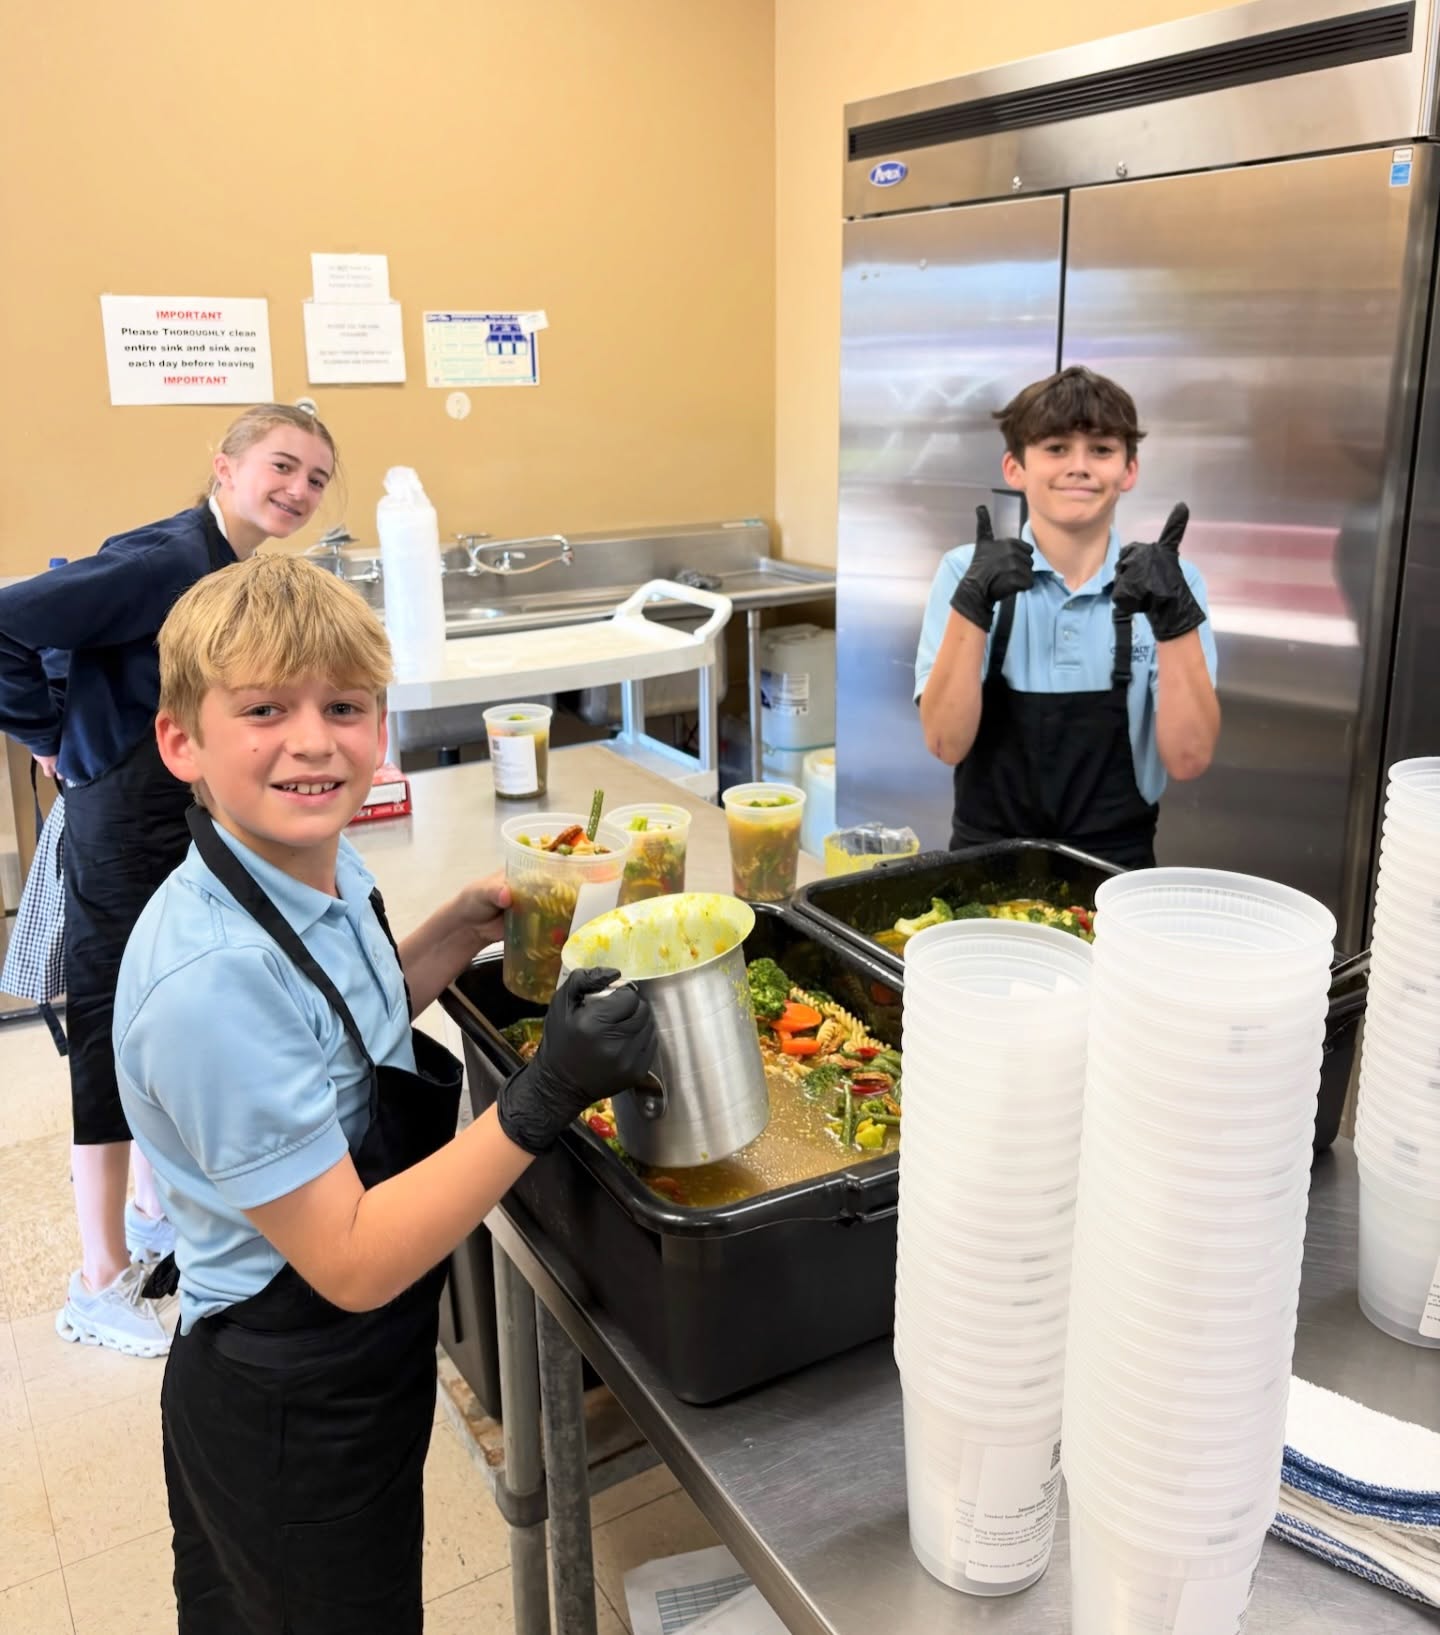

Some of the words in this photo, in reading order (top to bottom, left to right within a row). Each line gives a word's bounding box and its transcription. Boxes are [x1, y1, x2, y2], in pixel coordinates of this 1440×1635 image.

[156, 311, 223, 320] IMPORTANT
[121, 327, 159, 337] Please
[163, 328, 226, 337] THOROUGHLY
[229, 329, 257, 337] clean
[124, 344, 157, 352] entire
[161, 344, 184, 352] sink
[186, 344, 206, 352] and
[209, 344, 231, 353] sink
[128, 360, 155, 368] each
[159, 360, 178, 369] day
[181, 360, 215, 369] before
[218, 360, 255, 370] leaving
[163, 376, 227, 385] IMPORTANT
